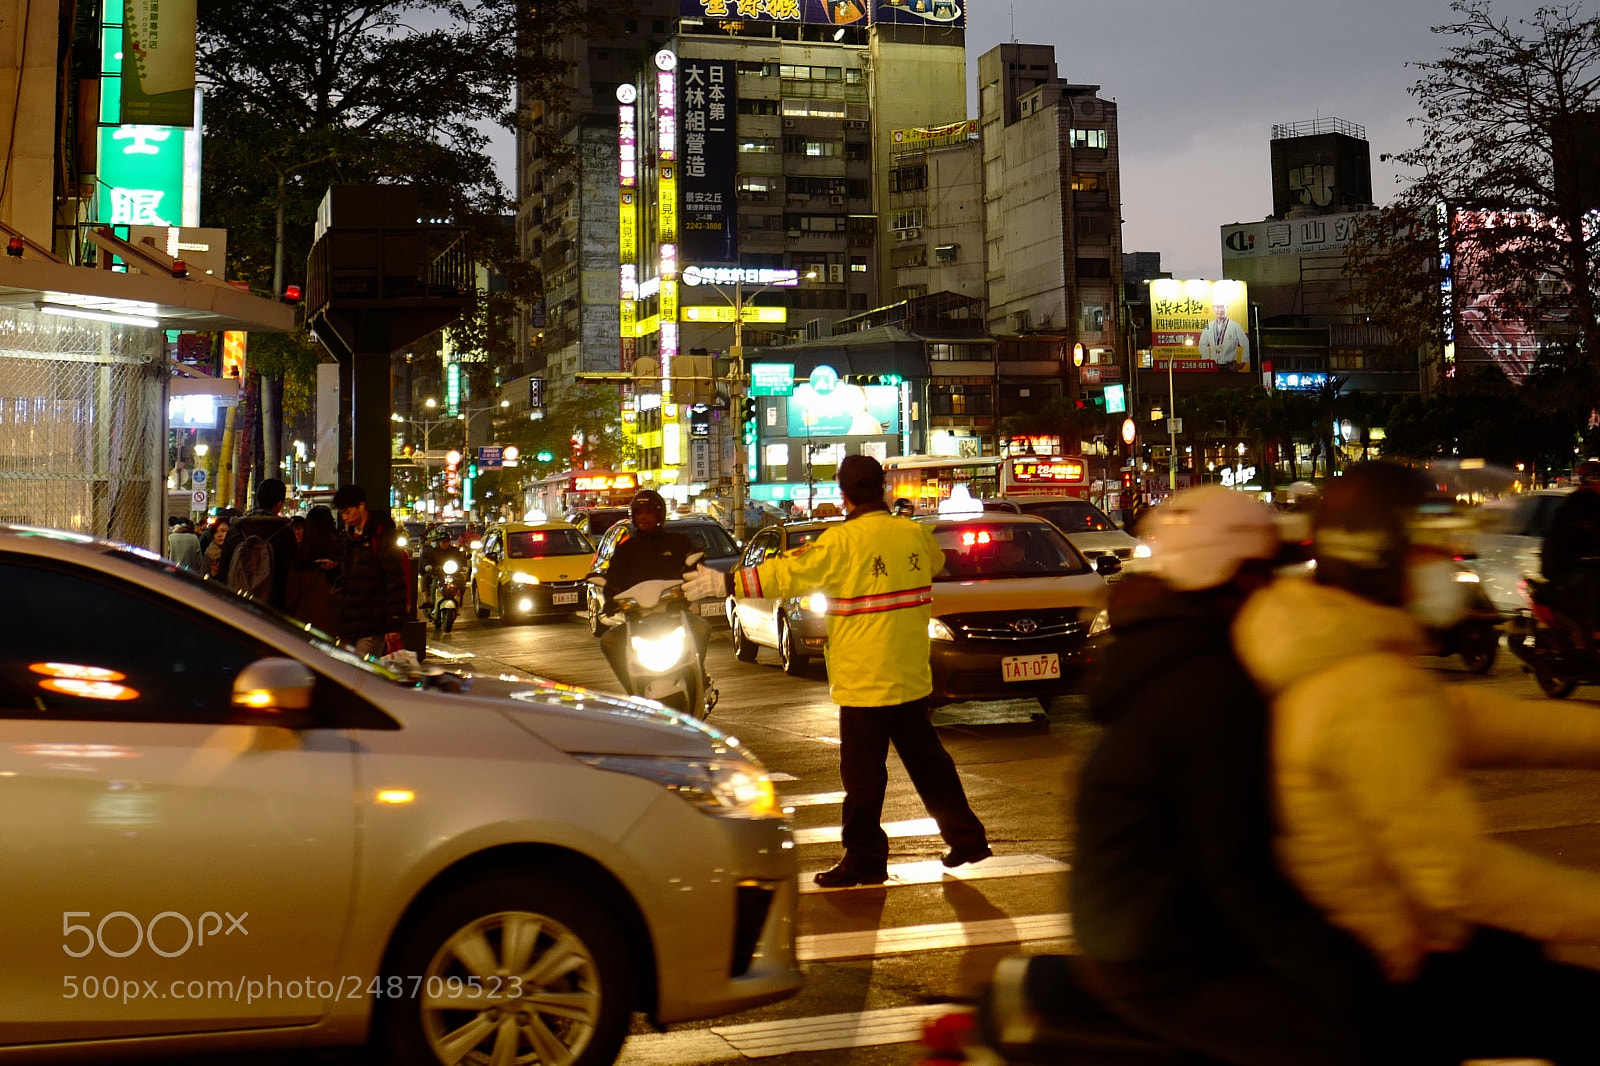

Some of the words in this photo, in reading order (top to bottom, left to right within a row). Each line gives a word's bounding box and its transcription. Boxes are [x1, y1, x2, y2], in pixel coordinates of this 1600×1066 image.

[685, 64, 706, 178] 大林組營造
[709, 65, 726, 132] 日本第一
[661, 191, 673, 239] 科見美語
